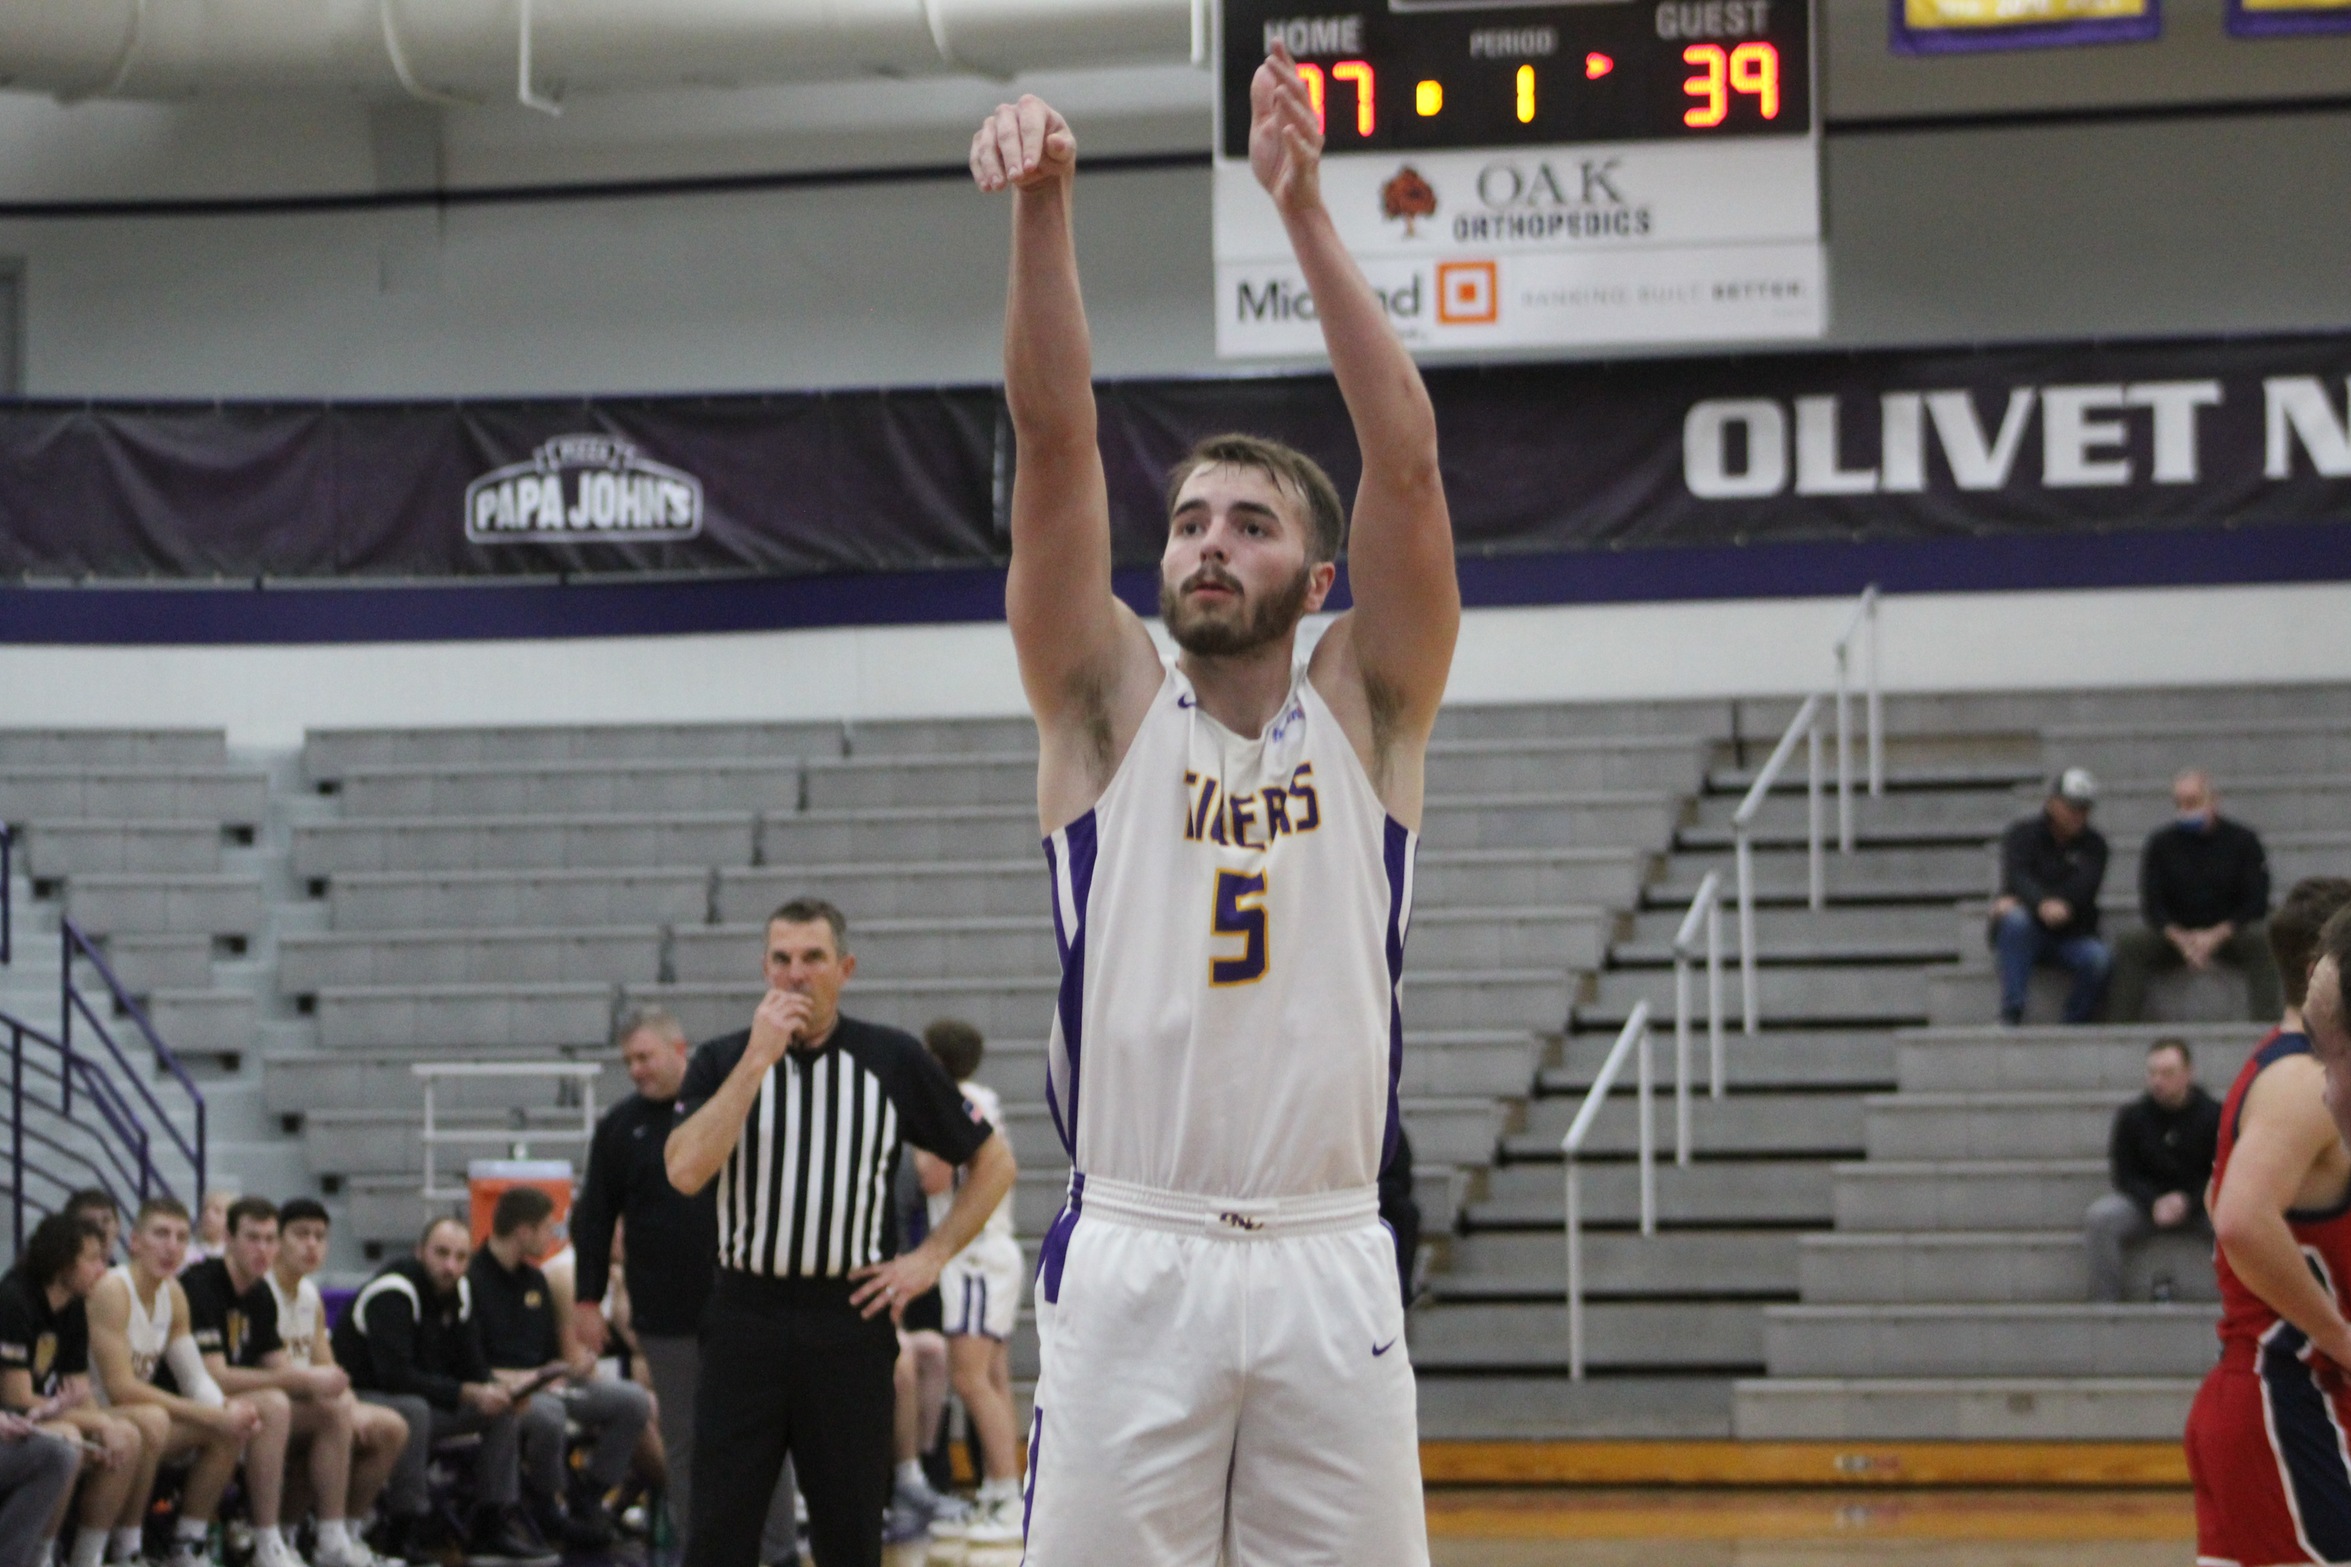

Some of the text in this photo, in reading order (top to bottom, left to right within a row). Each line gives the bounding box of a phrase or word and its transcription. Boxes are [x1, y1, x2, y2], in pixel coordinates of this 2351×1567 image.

[1263, 16, 1363, 56] HOME
[1469, 29, 1557, 58] PERIOD
[1655, 2, 1769, 40] GUEST
[1516, 64, 1535, 124] 1
[1683, 41, 1779, 128] 39
[1477, 159, 1624, 208] OAK
[1453, 207, 1652, 241] ORTHOPEDICS
[1683, 378, 2222, 499] OLIVET
[476, 470, 692, 530] PAPA JOHN'S
[1208, 867, 1270, 988] 5
